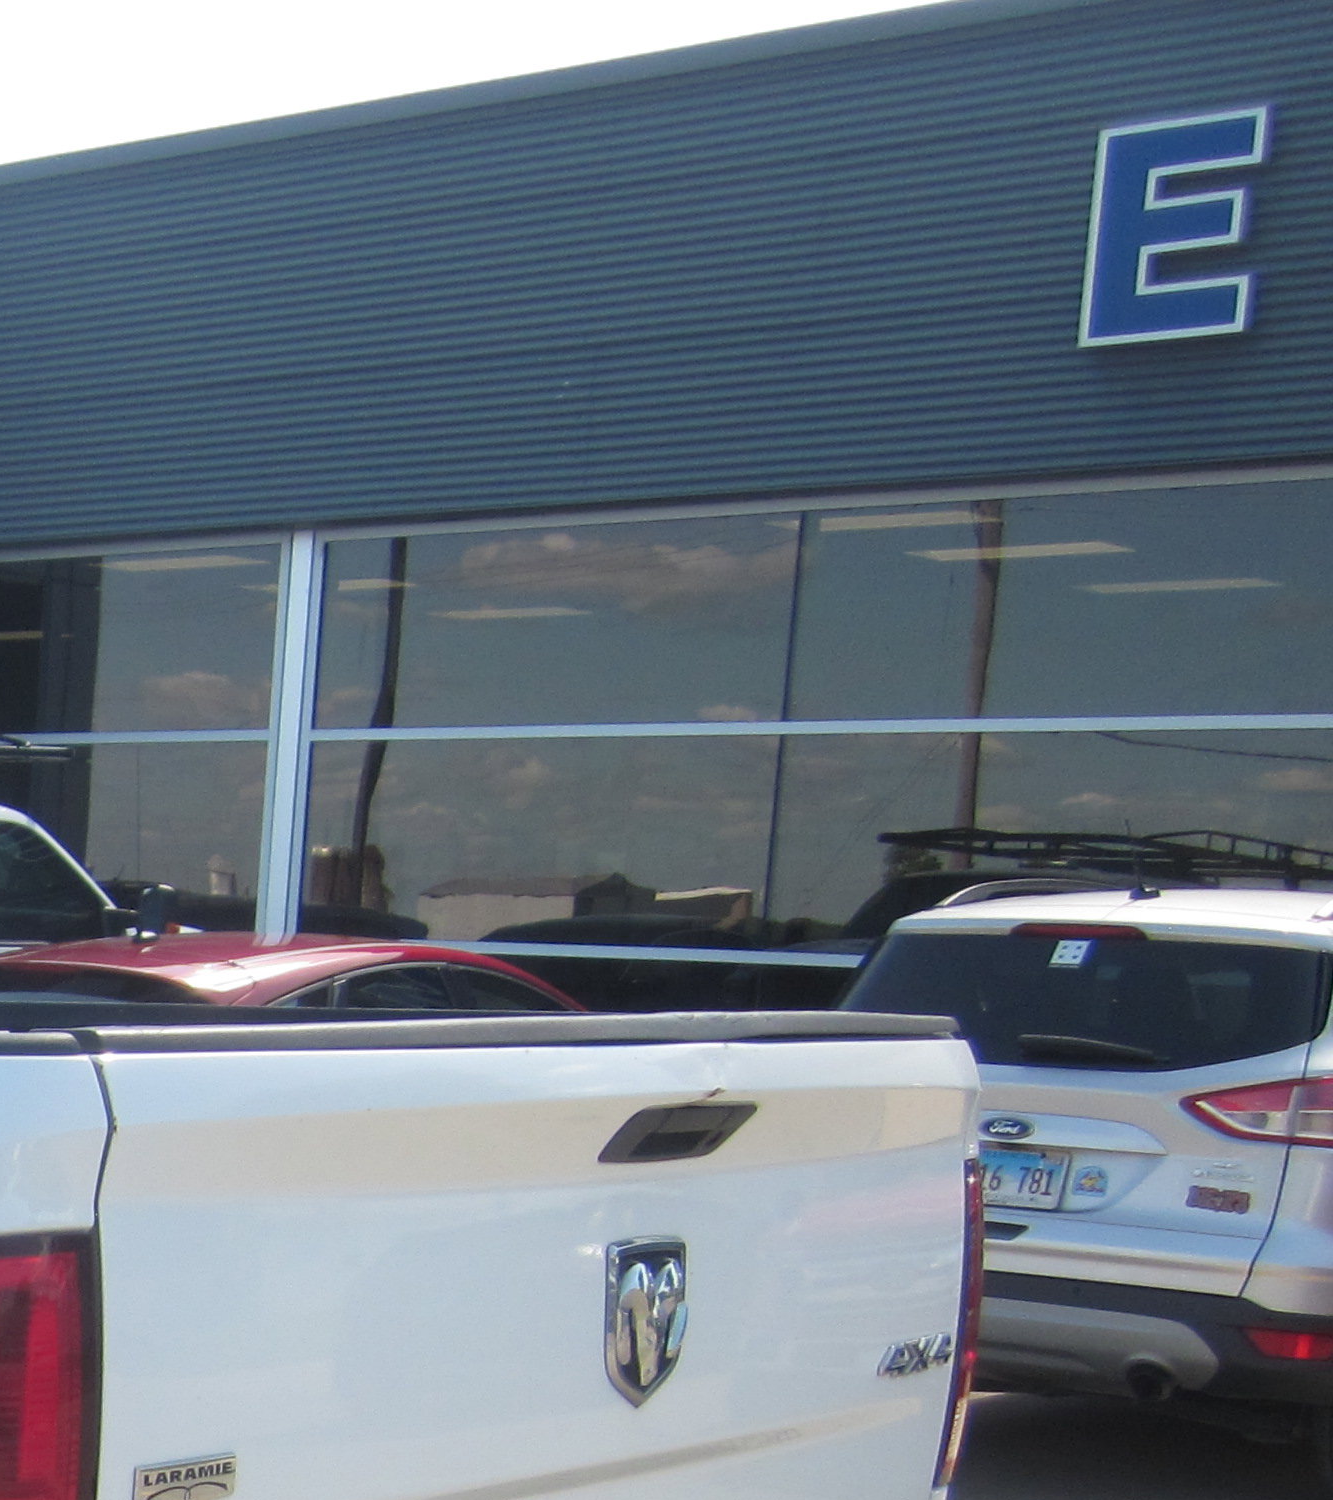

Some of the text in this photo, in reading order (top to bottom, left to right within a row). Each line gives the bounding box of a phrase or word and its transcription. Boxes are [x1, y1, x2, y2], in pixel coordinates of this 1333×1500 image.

[1077, 105, 1269, 349] E
[988, 1119, 1022, 1135] Ford
[1017, 1166, 1055, 1196] 781
[143, 1461, 235, 1487] LARAMIE
